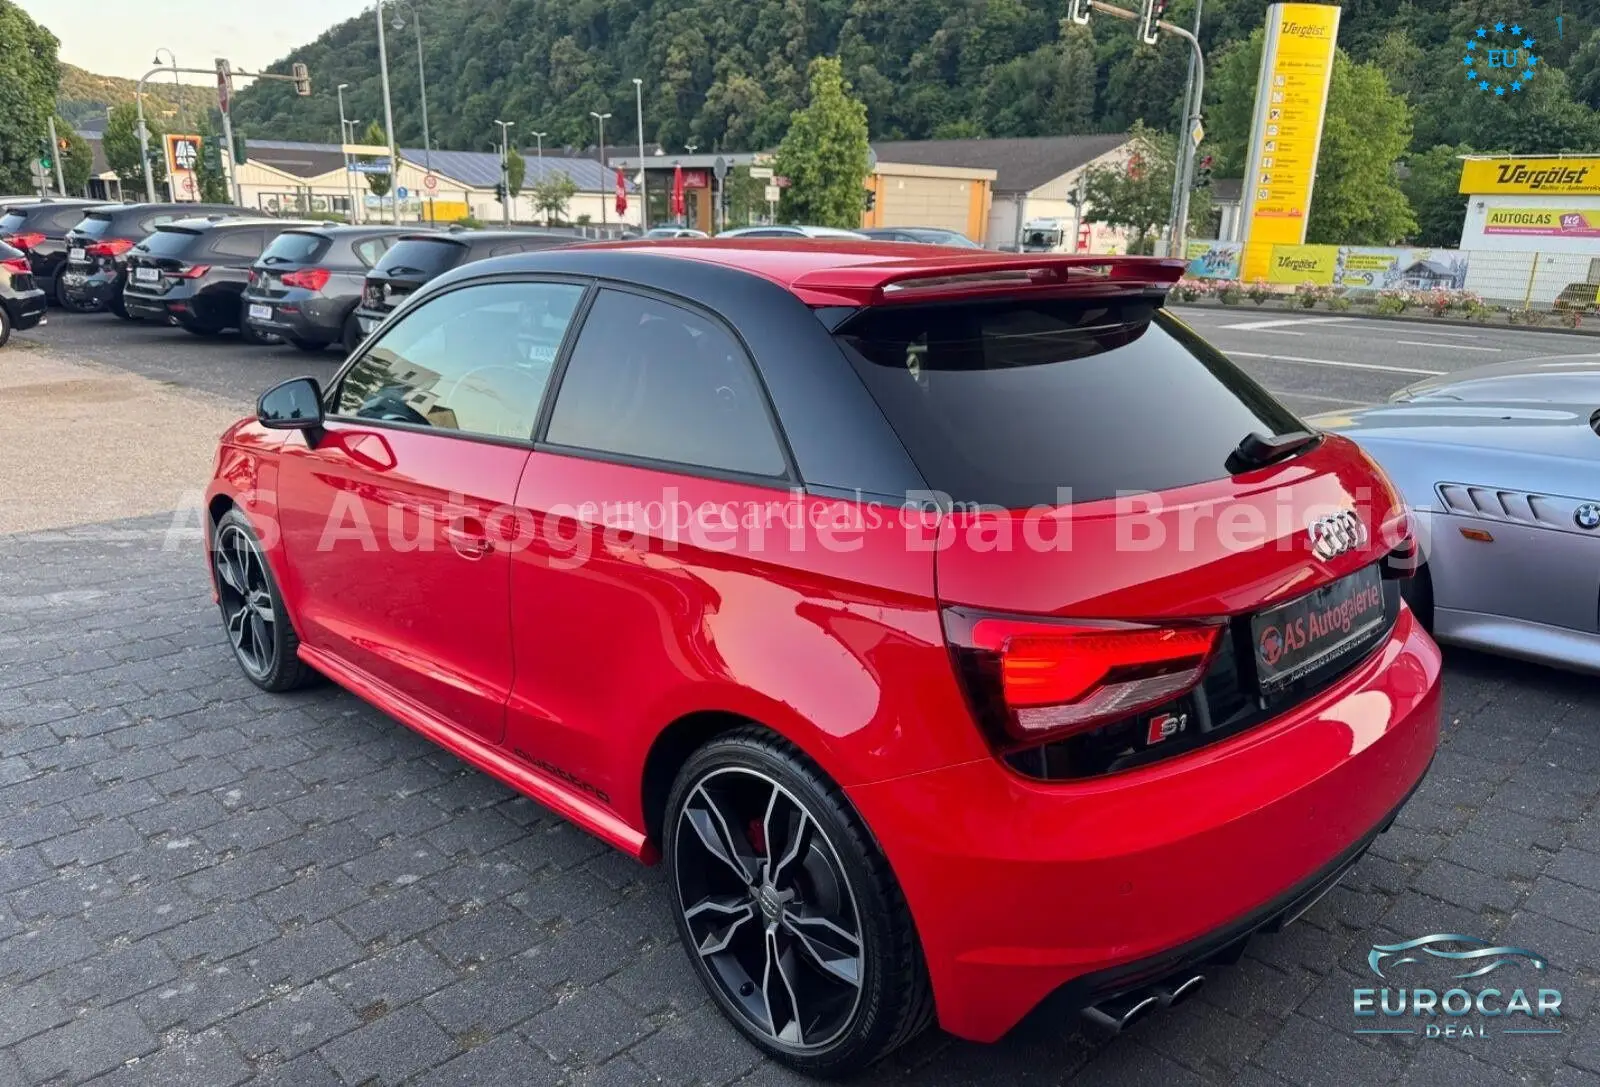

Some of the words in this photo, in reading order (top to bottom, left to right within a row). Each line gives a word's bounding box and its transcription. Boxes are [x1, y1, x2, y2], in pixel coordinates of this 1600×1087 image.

[1497, 164, 1589, 189] Vergölst
[1491, 213, 1552, 225] AUTOGLAS
[1283, 619, 1306, 654] AS
[1308, 582, 1379, 634] Autogalerie
